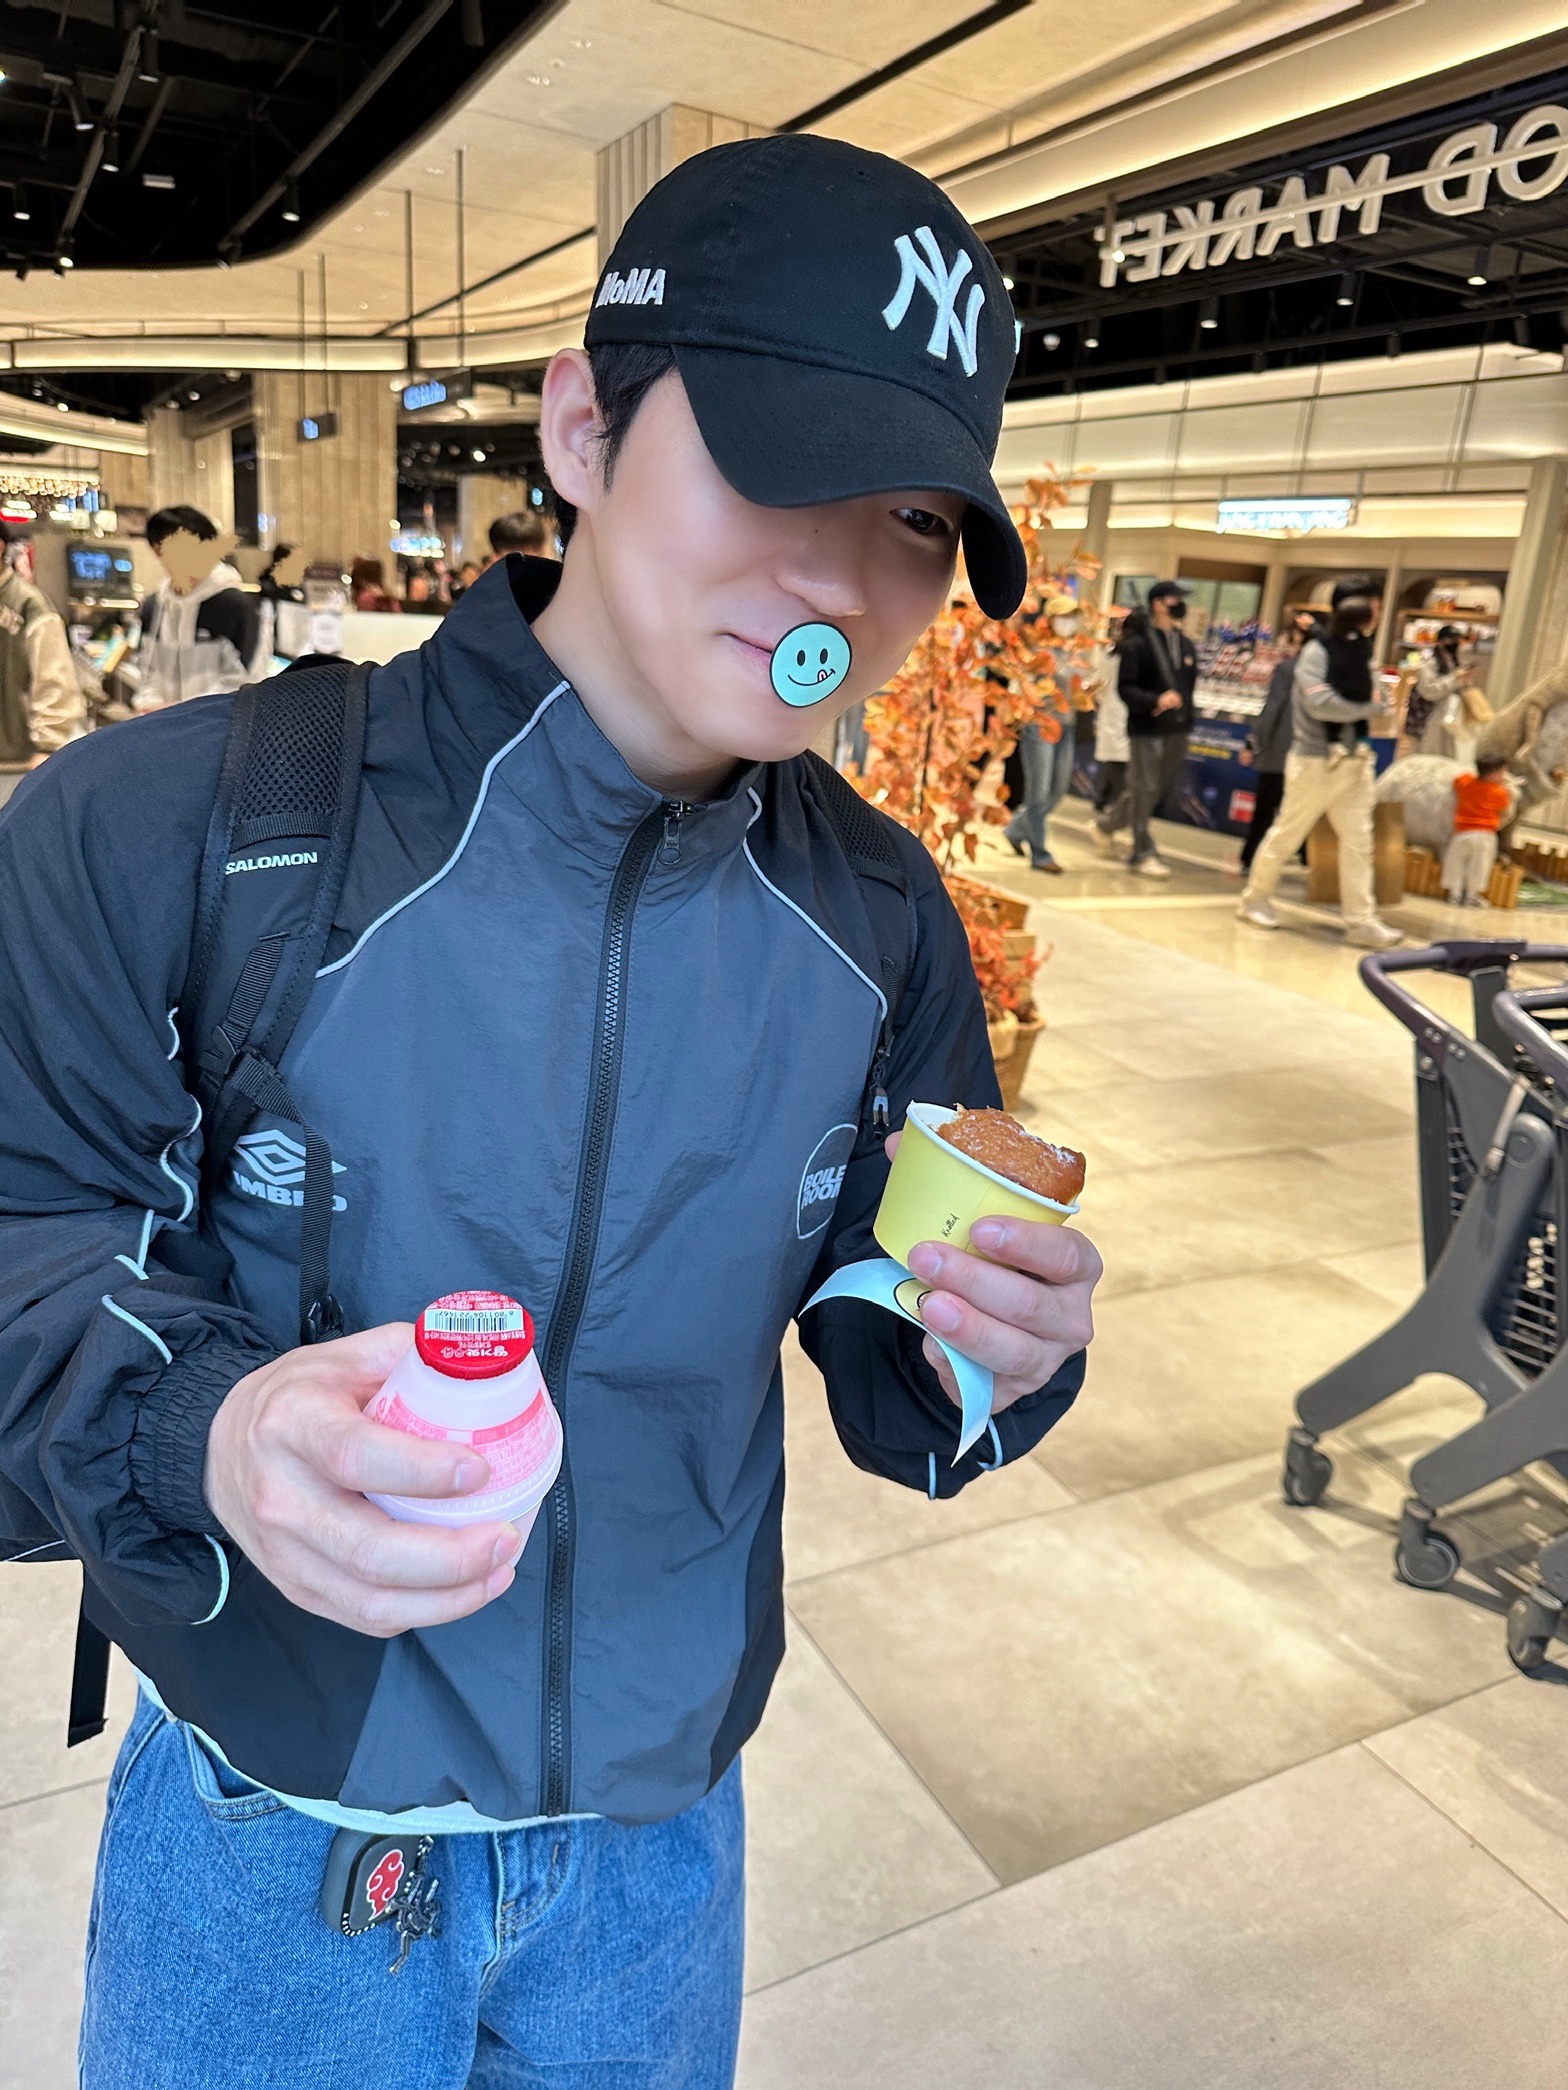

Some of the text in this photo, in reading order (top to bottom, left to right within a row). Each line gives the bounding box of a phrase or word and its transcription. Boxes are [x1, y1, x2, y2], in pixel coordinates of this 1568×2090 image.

[595, 267, 667, 309] MoMA
[881, 225, 986, 378] NY
[225, 852, 318, 875] SALOMON
